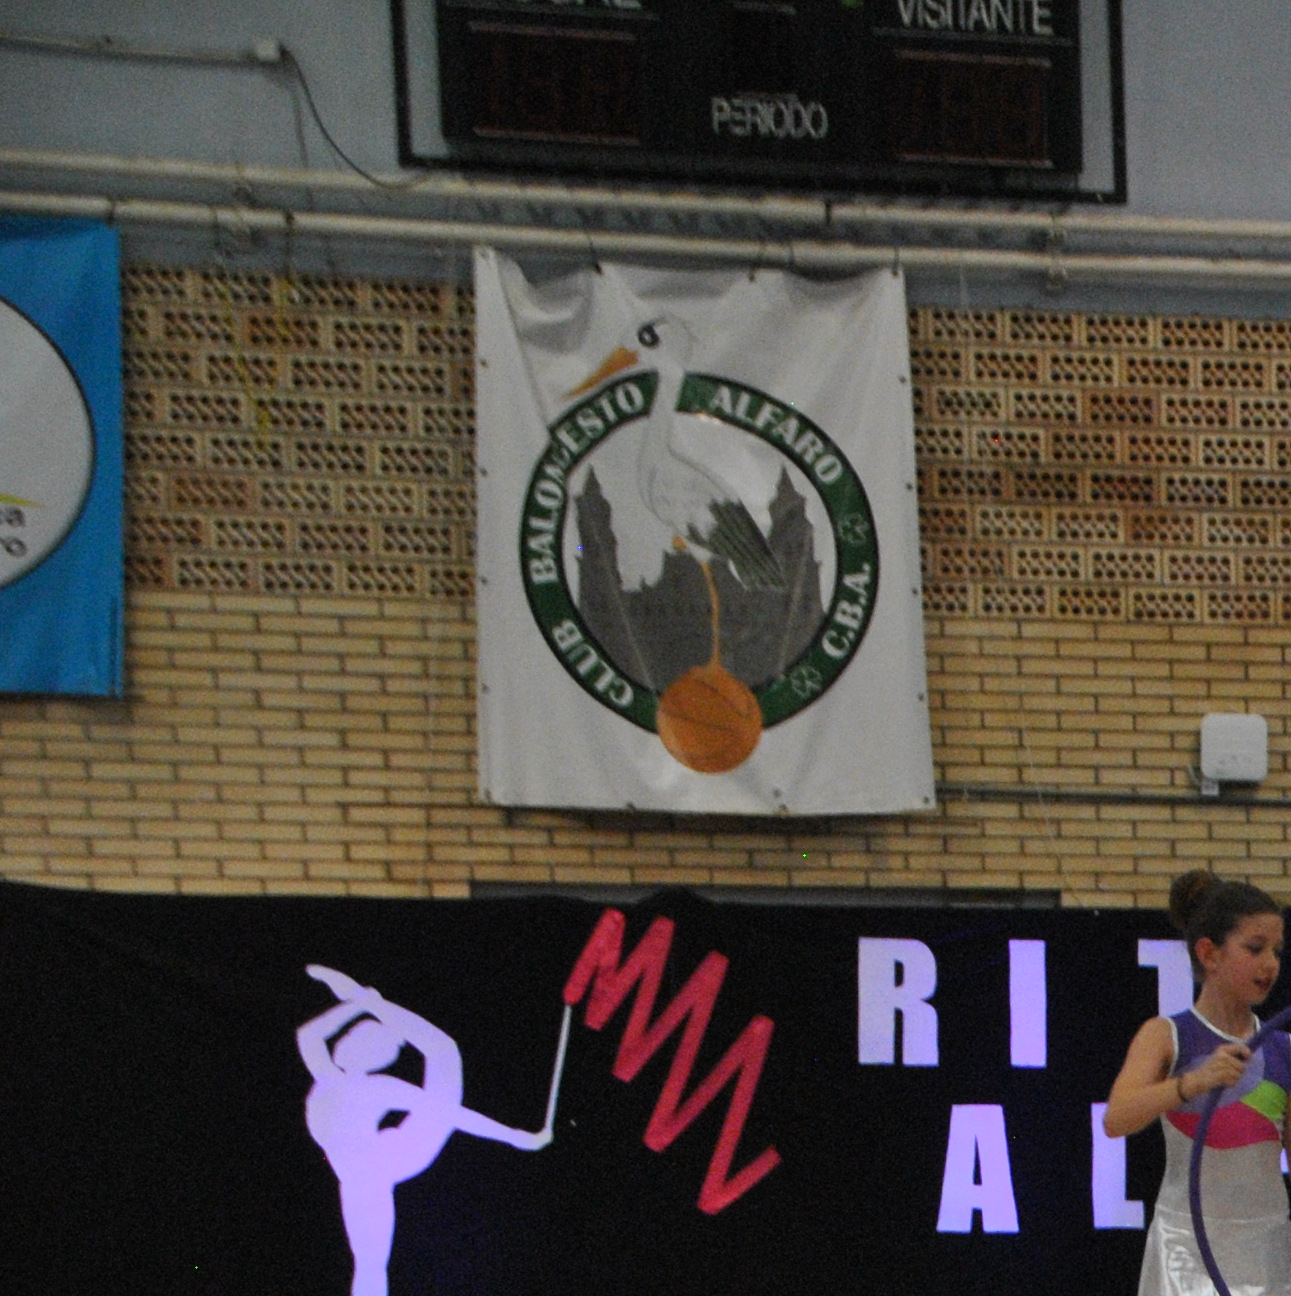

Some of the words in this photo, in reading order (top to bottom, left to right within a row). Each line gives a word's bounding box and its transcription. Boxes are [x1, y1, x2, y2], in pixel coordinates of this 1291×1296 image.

[898, 0, 1054, 37] VISITANTE
[551, 618, 635, 707] CLUB
[709, 384, 845, 485] ALFARO
